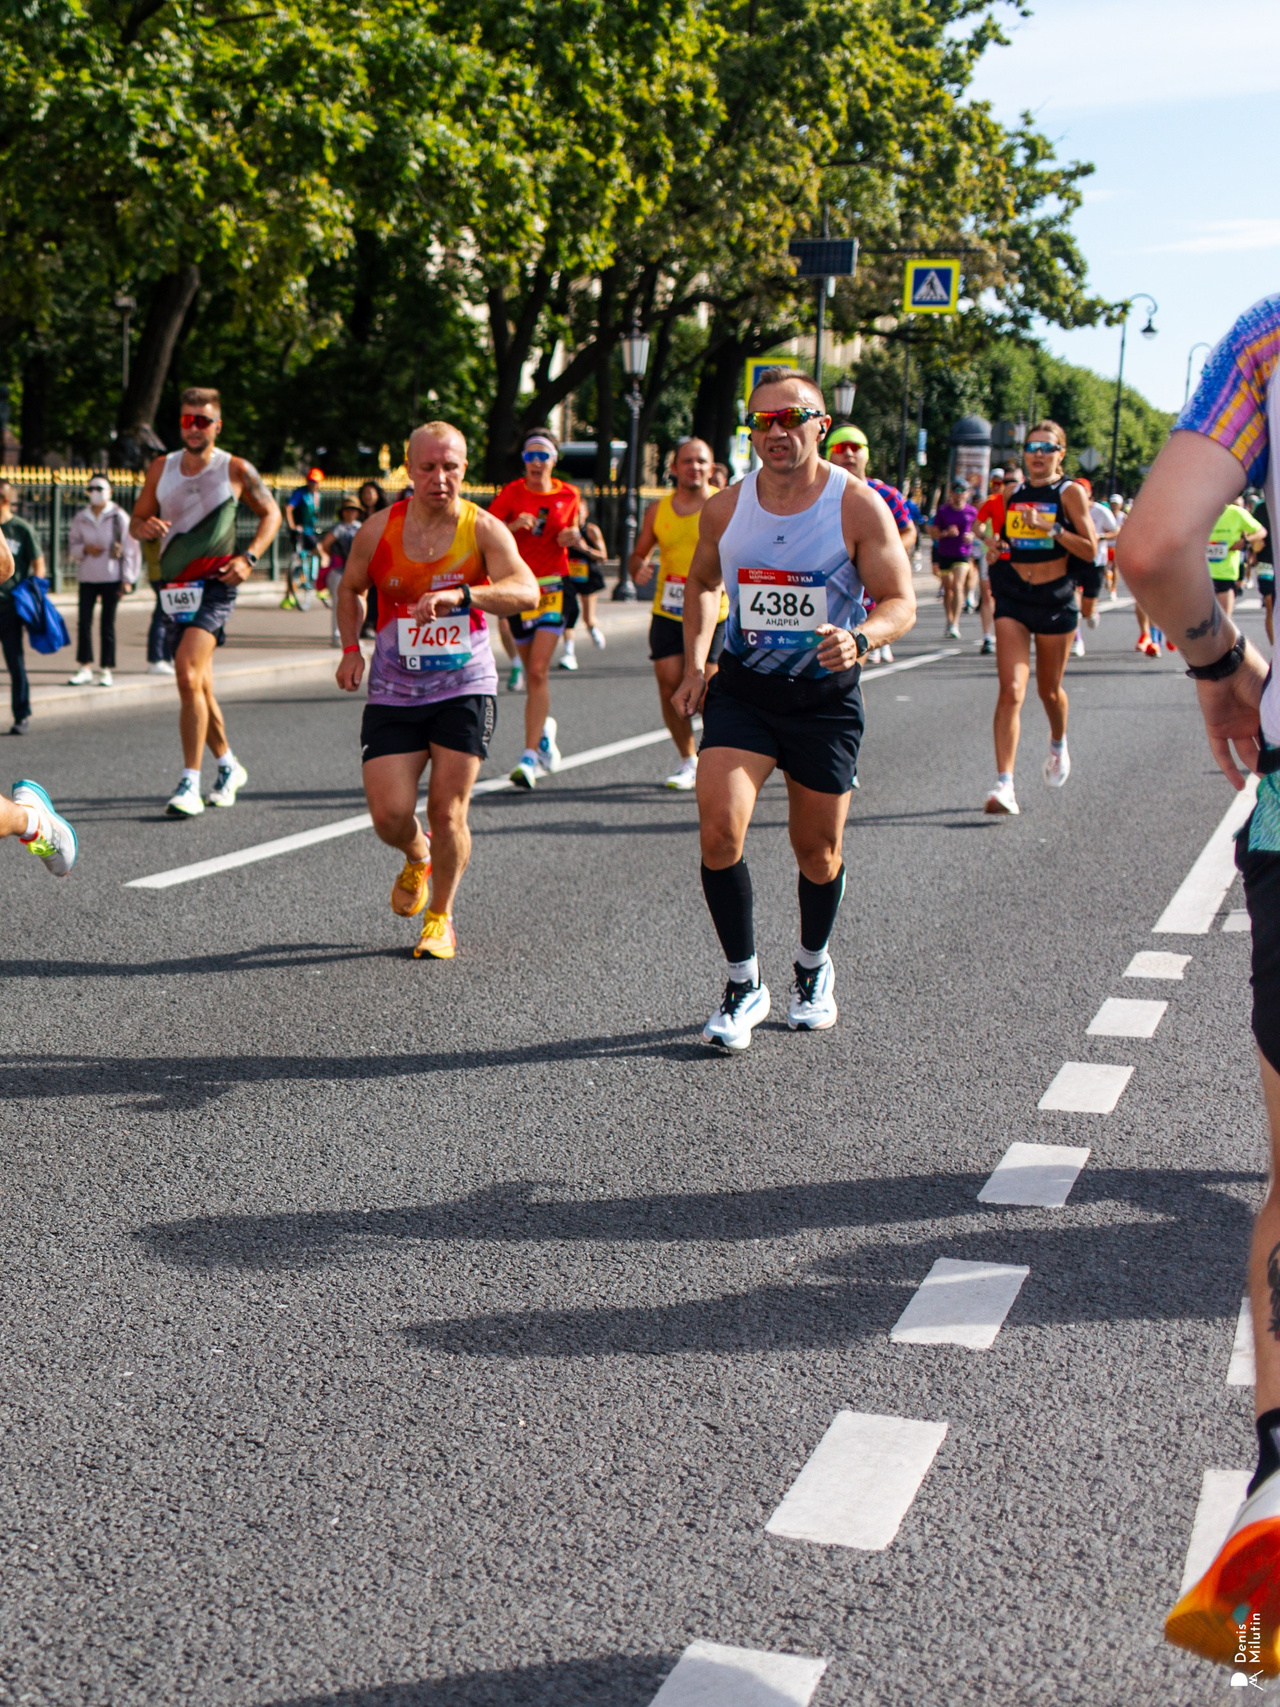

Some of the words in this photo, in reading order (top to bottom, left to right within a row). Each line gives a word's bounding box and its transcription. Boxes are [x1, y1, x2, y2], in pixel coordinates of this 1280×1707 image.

[167, 591, 196, 606] 1481
[750, 591, 815, 617] 4386
[765, 618, 800, 627] АНДРЕЙ
[407, 625, 461, 647] 7402
[747, 631, 758, 646] C
